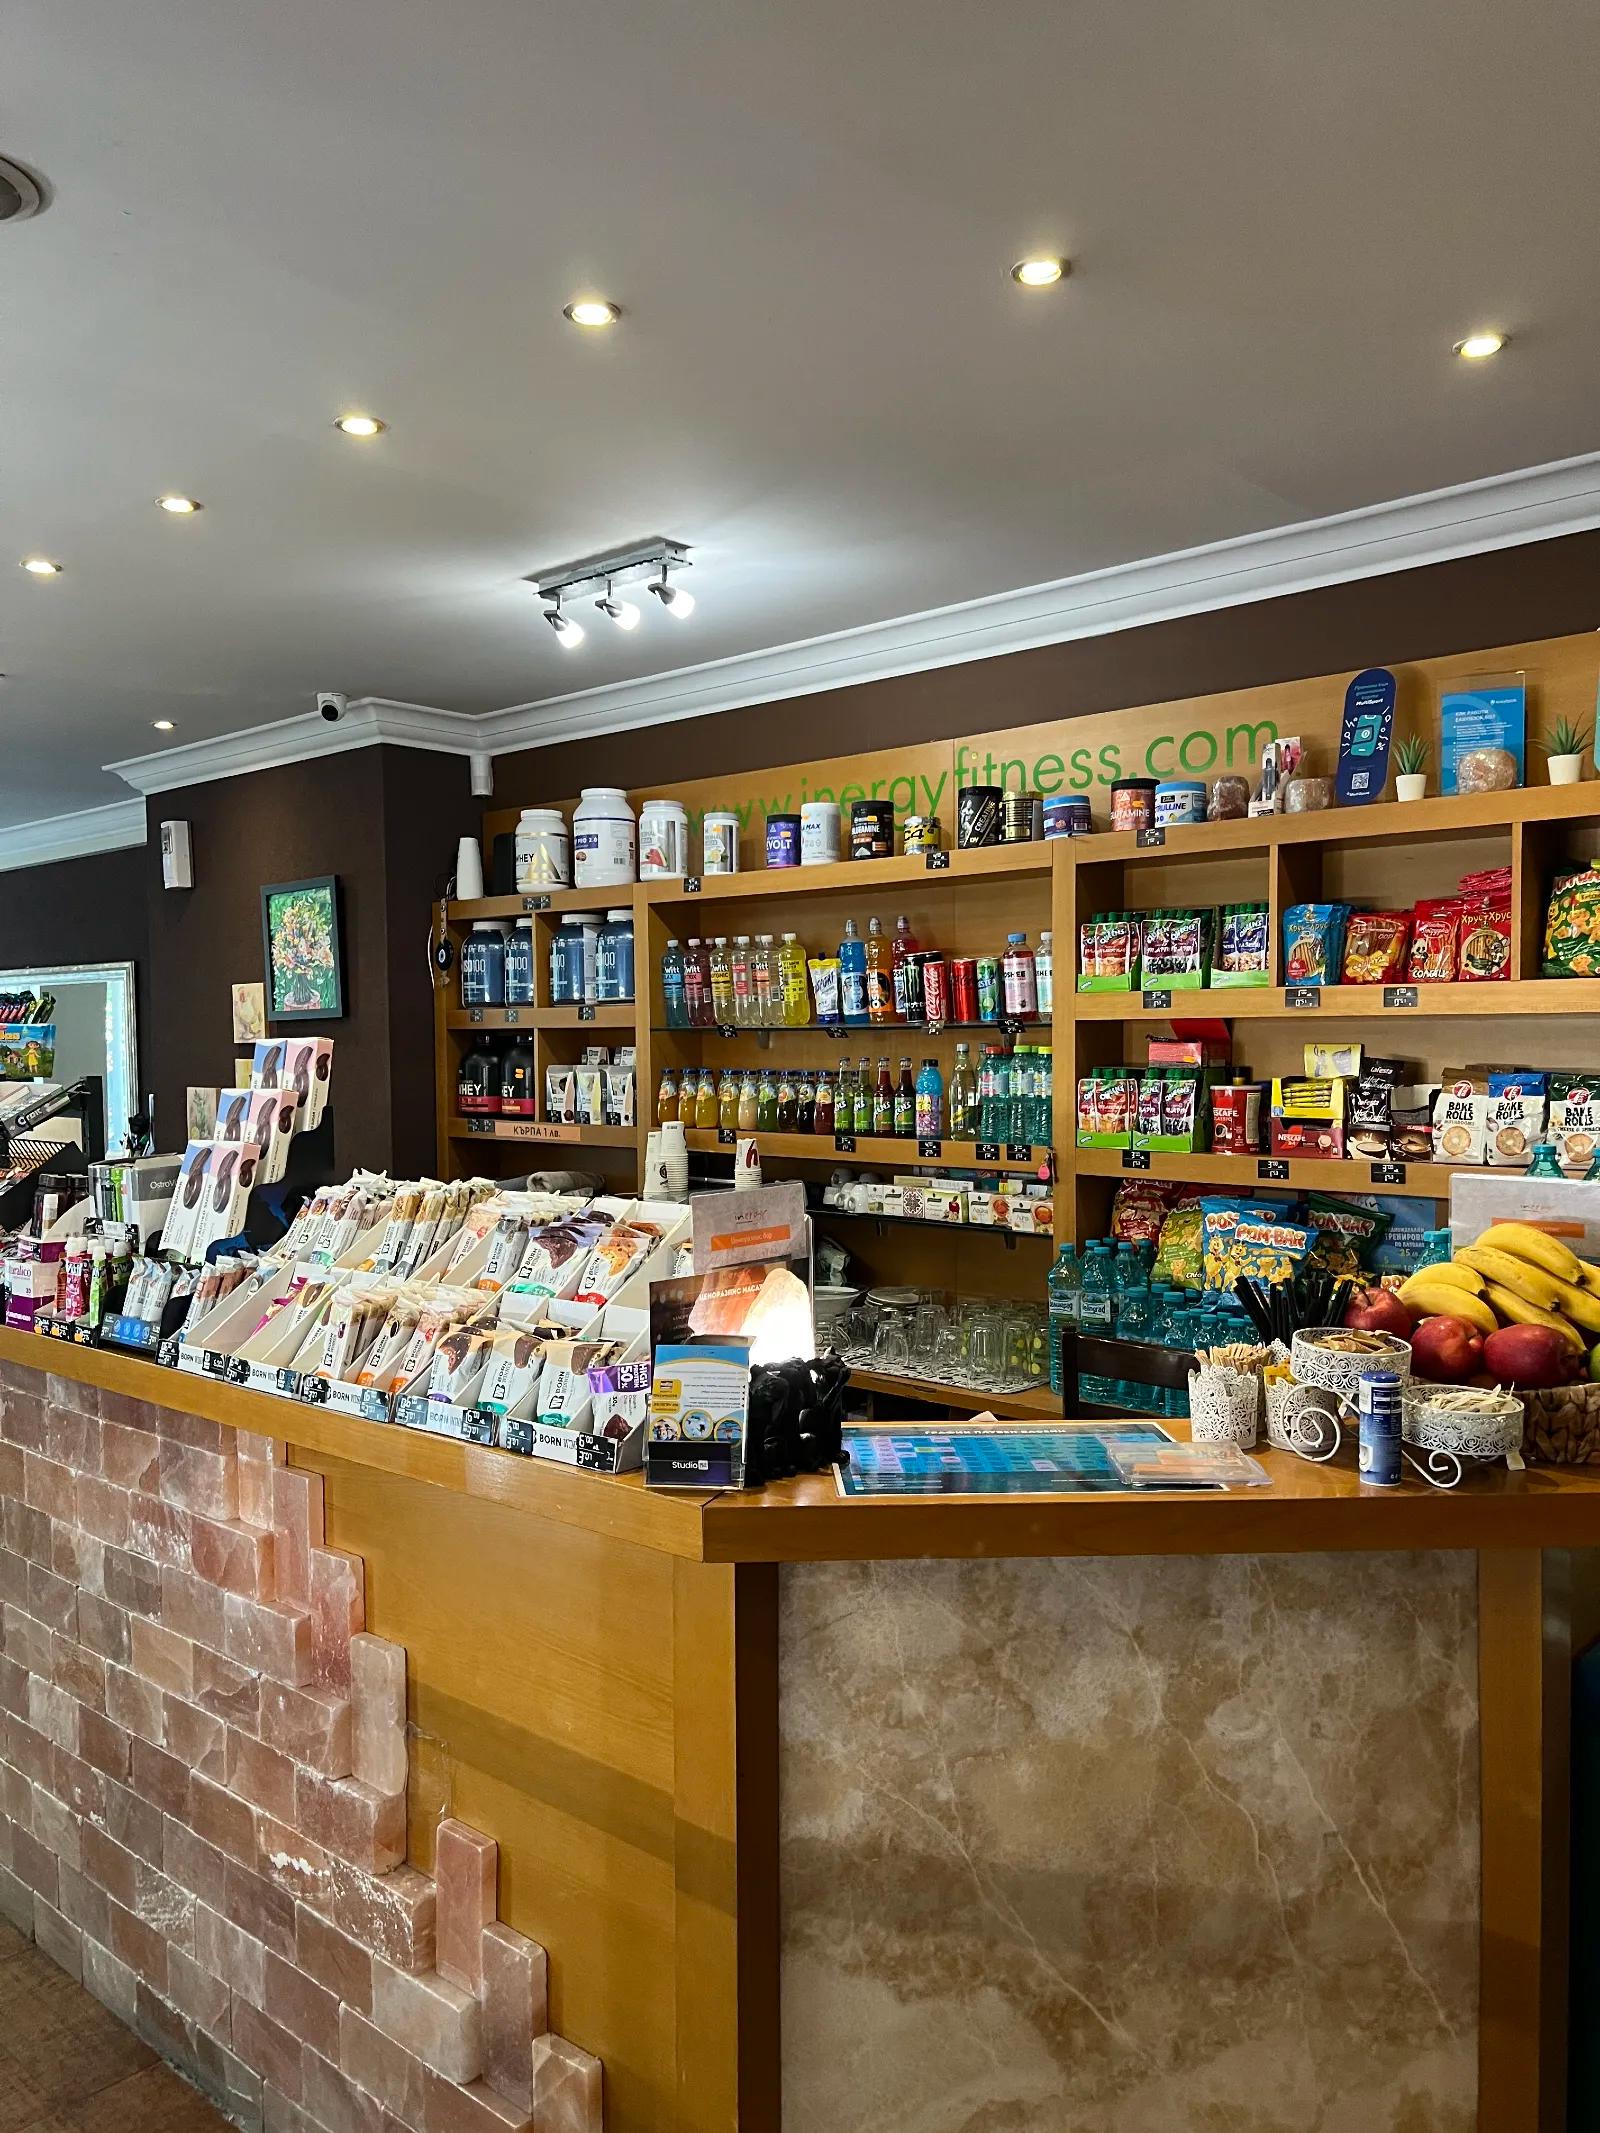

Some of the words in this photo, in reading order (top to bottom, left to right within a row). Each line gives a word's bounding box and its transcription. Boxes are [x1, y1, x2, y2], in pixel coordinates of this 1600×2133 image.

[974, 800, 996, 832] CREATINE
[1448, 1101, 1474, 1111] BAKE
[1498, 1101, 1523, 1111] BAKE
[1446, 1110, 1474, 1121] ROLLS
[1495, 1110, 1524, 1120] ROLLS
[1565, 1107, 1592, 1117] BAKE
[1564, 1115, 1593, 1127] ROLLS
[513, 1127, 542, 1137] КЪРПА
[543, 1128, 548, 1137] 1
[180, 1352, 194, 1362] BORN
[251, 1368, 267, 1379] BORN
[497, 1360, 508, 1385] BORN
[620, 1365, 634, 1389] 50%
[639, 1363, 649, 1389] HIGH
[555, 1371, 565, 1395] BORN
[333, 1390, 350, 1401] BORN
[429, 1409, 448, 1422] BORN
[539, 1433, 562, 1447] BORN
[672, 1461, 698, 1469] Studio
